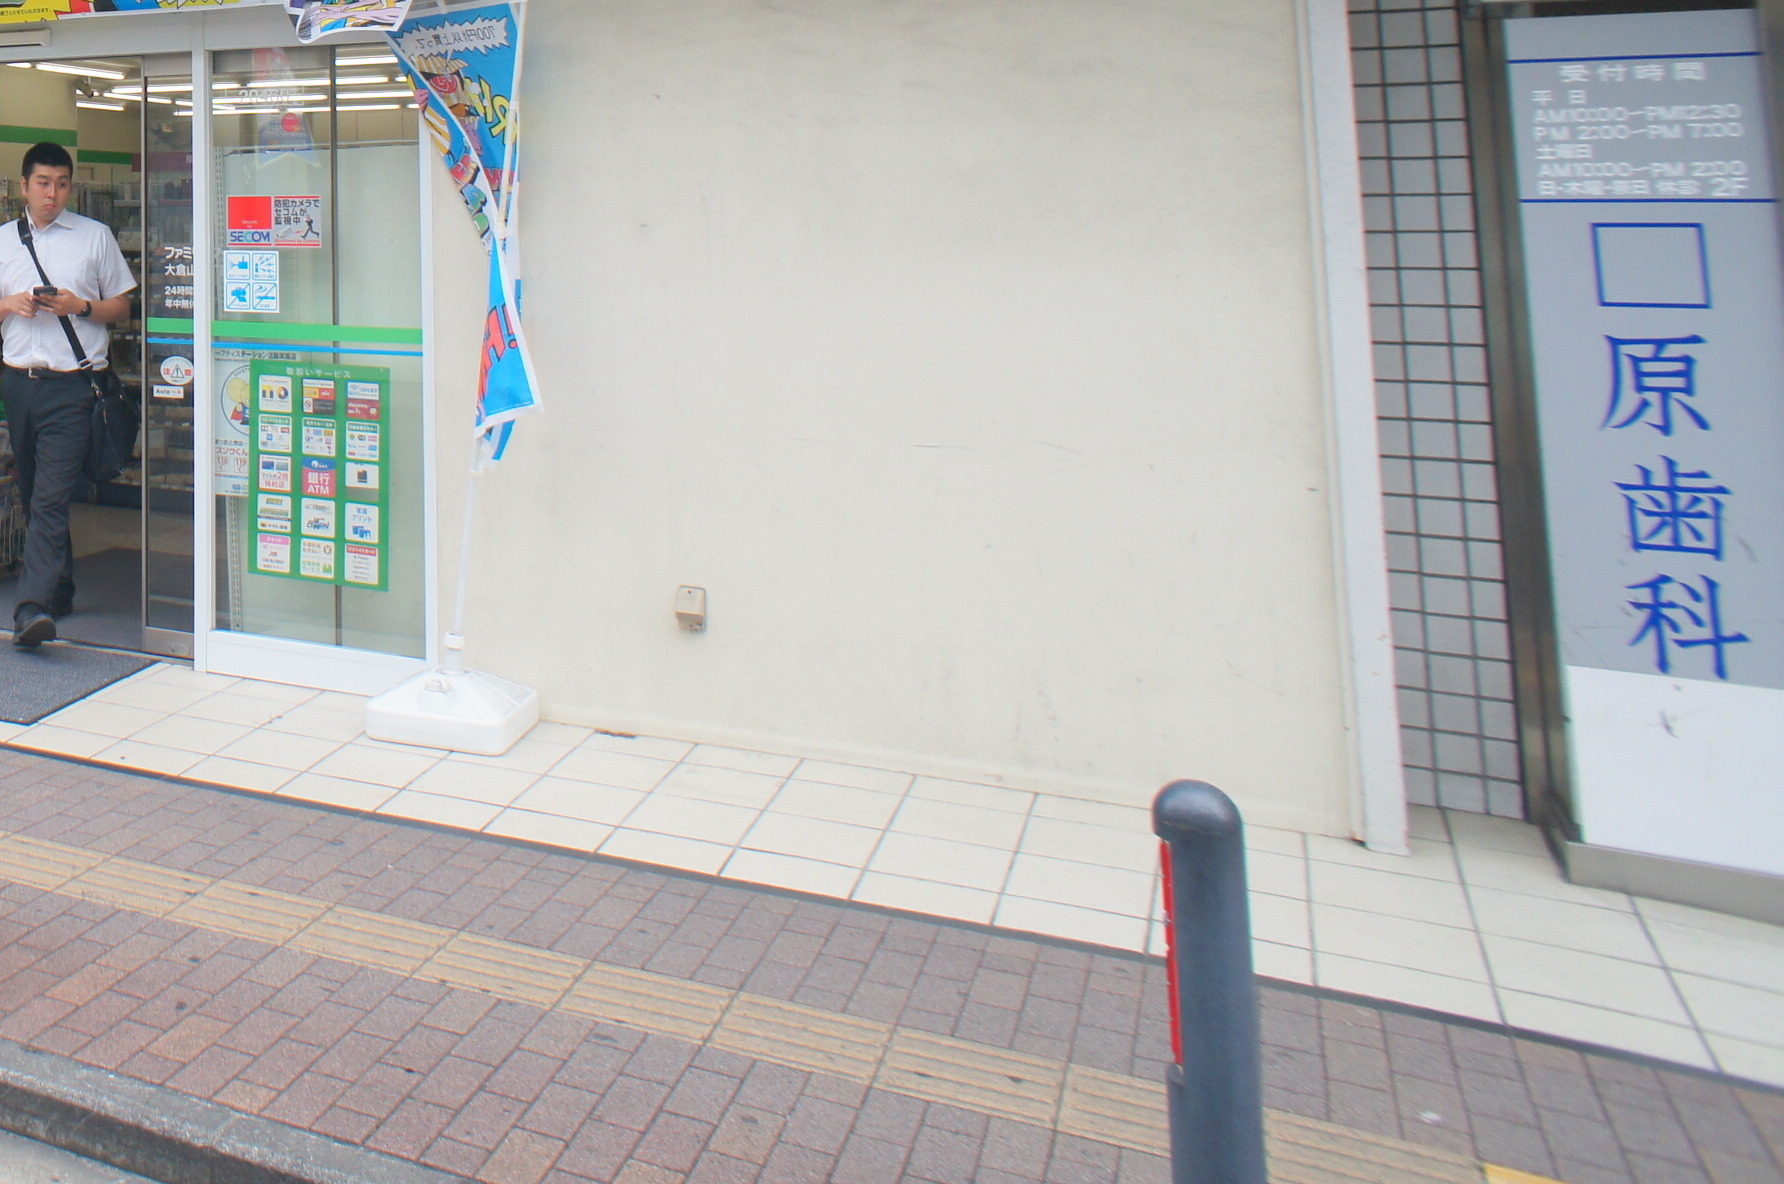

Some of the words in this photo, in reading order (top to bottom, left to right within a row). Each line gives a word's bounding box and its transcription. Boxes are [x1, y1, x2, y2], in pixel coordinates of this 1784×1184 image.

[1557, 63, 1705, 83] 受付時間
[1535, 143, 1593, 159] 土曜日
[275, 199, 320, 208] 防犯カメラで
[275, 207, 307, 216] セコムが
[230, 231, 270, 242] SECOM
[165, 246, 194, 259] ファミ
[286, 366, 351, 378] 取扱いサービス
[307, 471, 330, 485] 銀行
[307, 485, 330, 495] ATM
[1599, 333, 1752, 681] 原歯科
[352, 515, 373, 523] プリント
